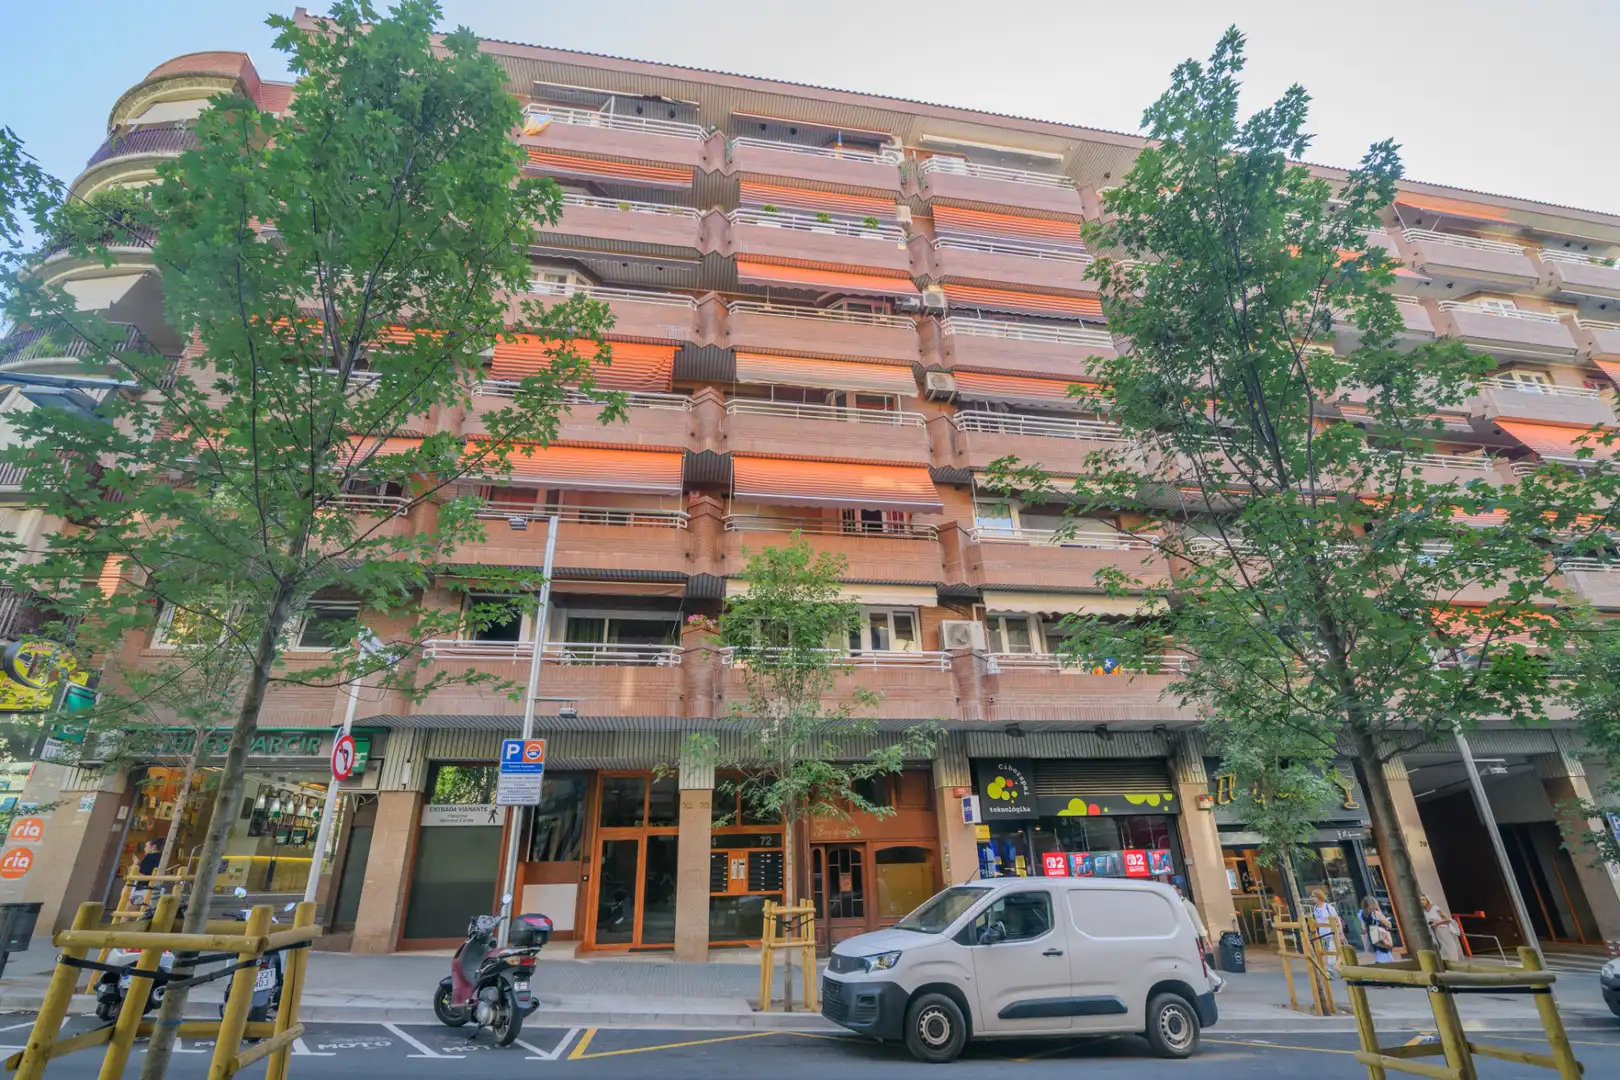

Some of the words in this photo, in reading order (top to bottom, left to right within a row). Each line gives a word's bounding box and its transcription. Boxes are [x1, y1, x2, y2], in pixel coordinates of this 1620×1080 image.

[248, 735, 322, 755] ARCIR
[506, 744, 520, 760] P
[14, 820, 40, 837] ria
[759, 836, 773, 846] 72
[3, 851, 30, 868] ria
[317, 1040, 392, 1050] MOTO
[442, 1045, 490, 1053] MOT
